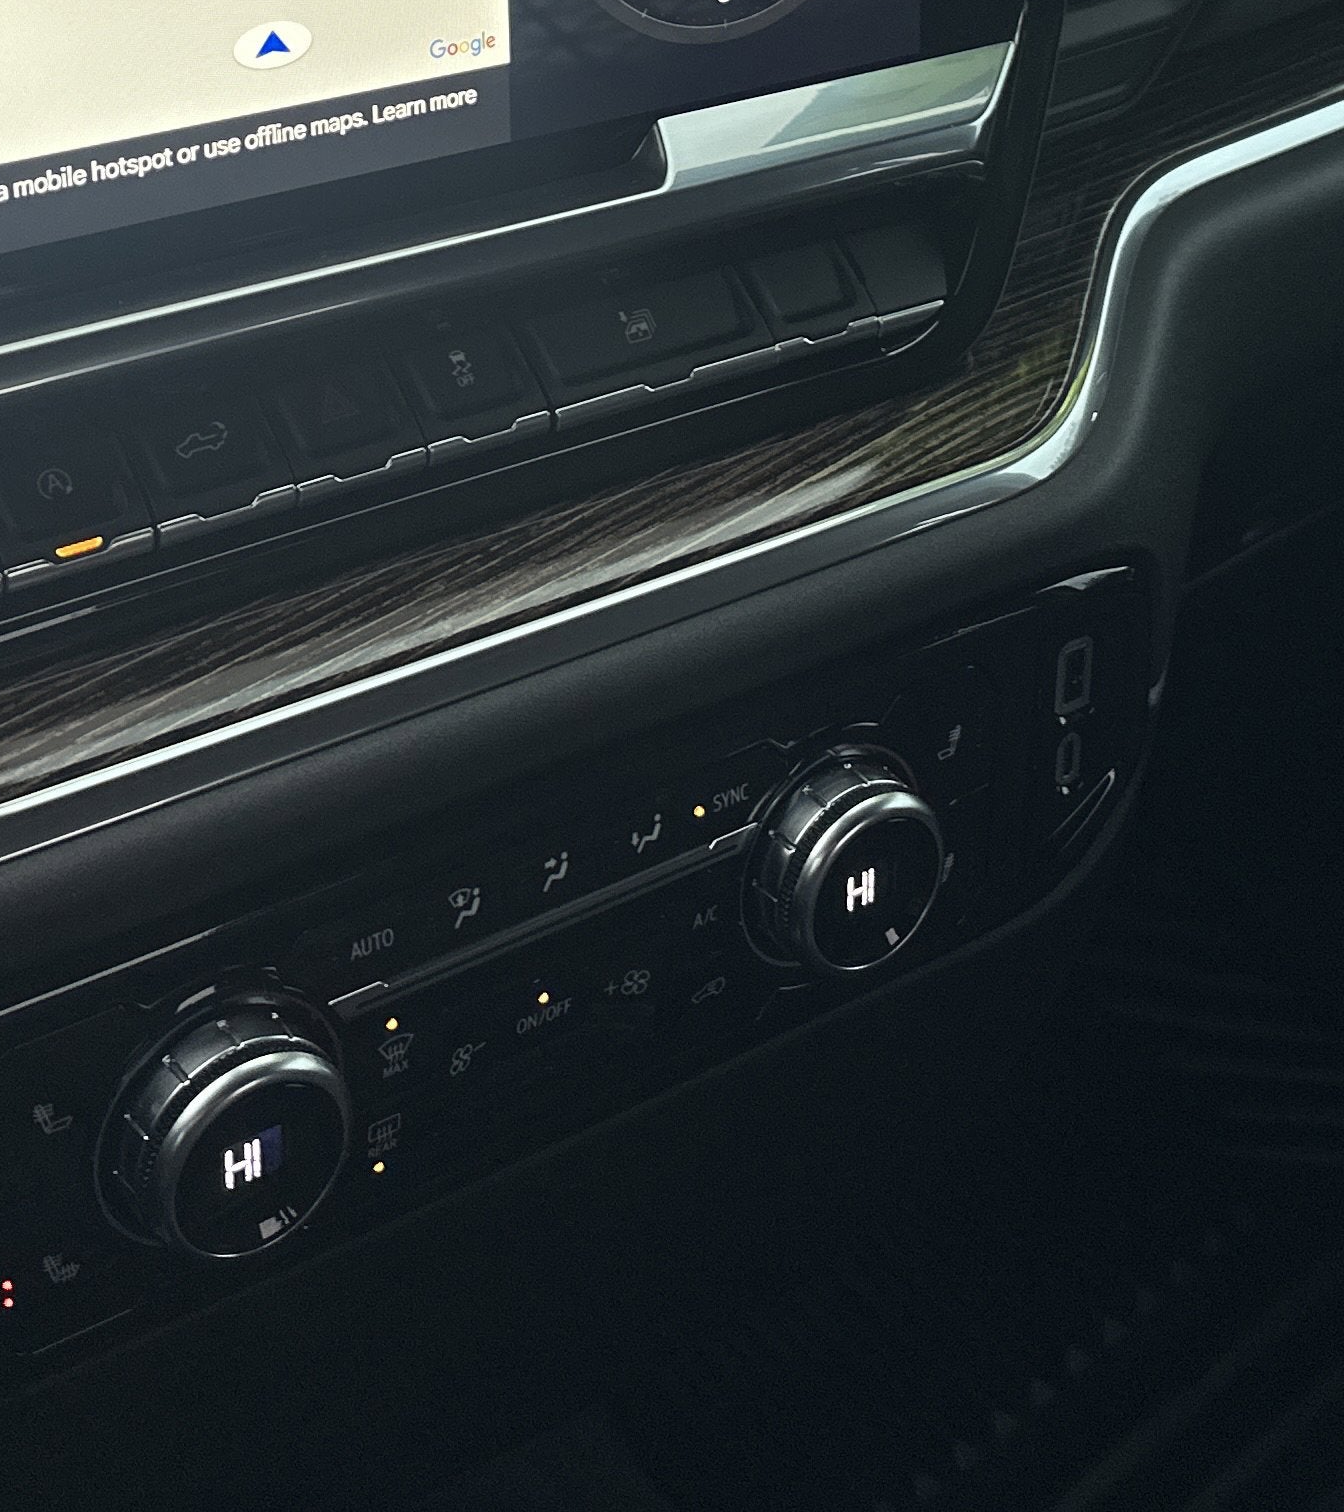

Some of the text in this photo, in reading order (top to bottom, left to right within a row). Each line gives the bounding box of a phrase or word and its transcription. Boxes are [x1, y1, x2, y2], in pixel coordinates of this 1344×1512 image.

[429, 31, 496, 59] Google
[13, 165, 88, 199] mobile
[91, 147, 174, 183] hotspot
[176, 144, 200, 165] or
[203, 136, 241, 160] use
[244, 120, 307, 151] offline
[310, 111, 368, 138] maps.
[371, 98, 427, 125] Learn
[429, 88, 478, 113] more
[711, 782, 751, 814] SYNC
[845, 866, 876, 913] HI
[692, 904, 719, 929] A/C
[350, 927, 395, 962] AUTO
[516, 998, 572, 1036] ON/OFF
[382, 1059, 409, 1079] MAX
[223, 1138, 262, 1190] HI
